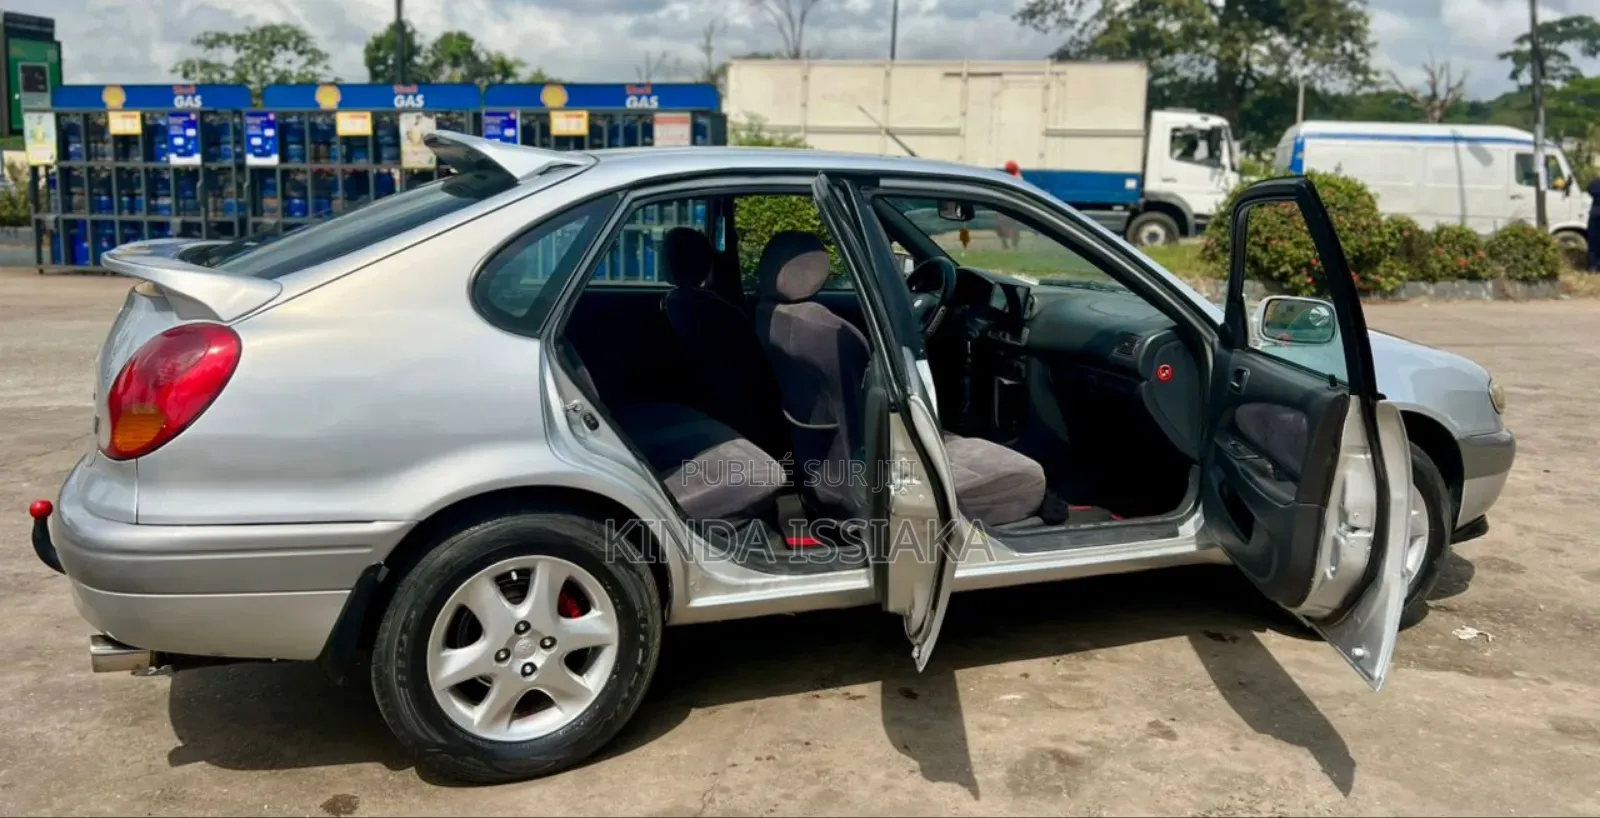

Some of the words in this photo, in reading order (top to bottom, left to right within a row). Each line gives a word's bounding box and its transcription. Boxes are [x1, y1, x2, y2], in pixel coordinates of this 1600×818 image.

[174, 94, 202, 108] GAS
[393, 94, 425, 108] GAS
[625, 94, 659, 109] GAS
